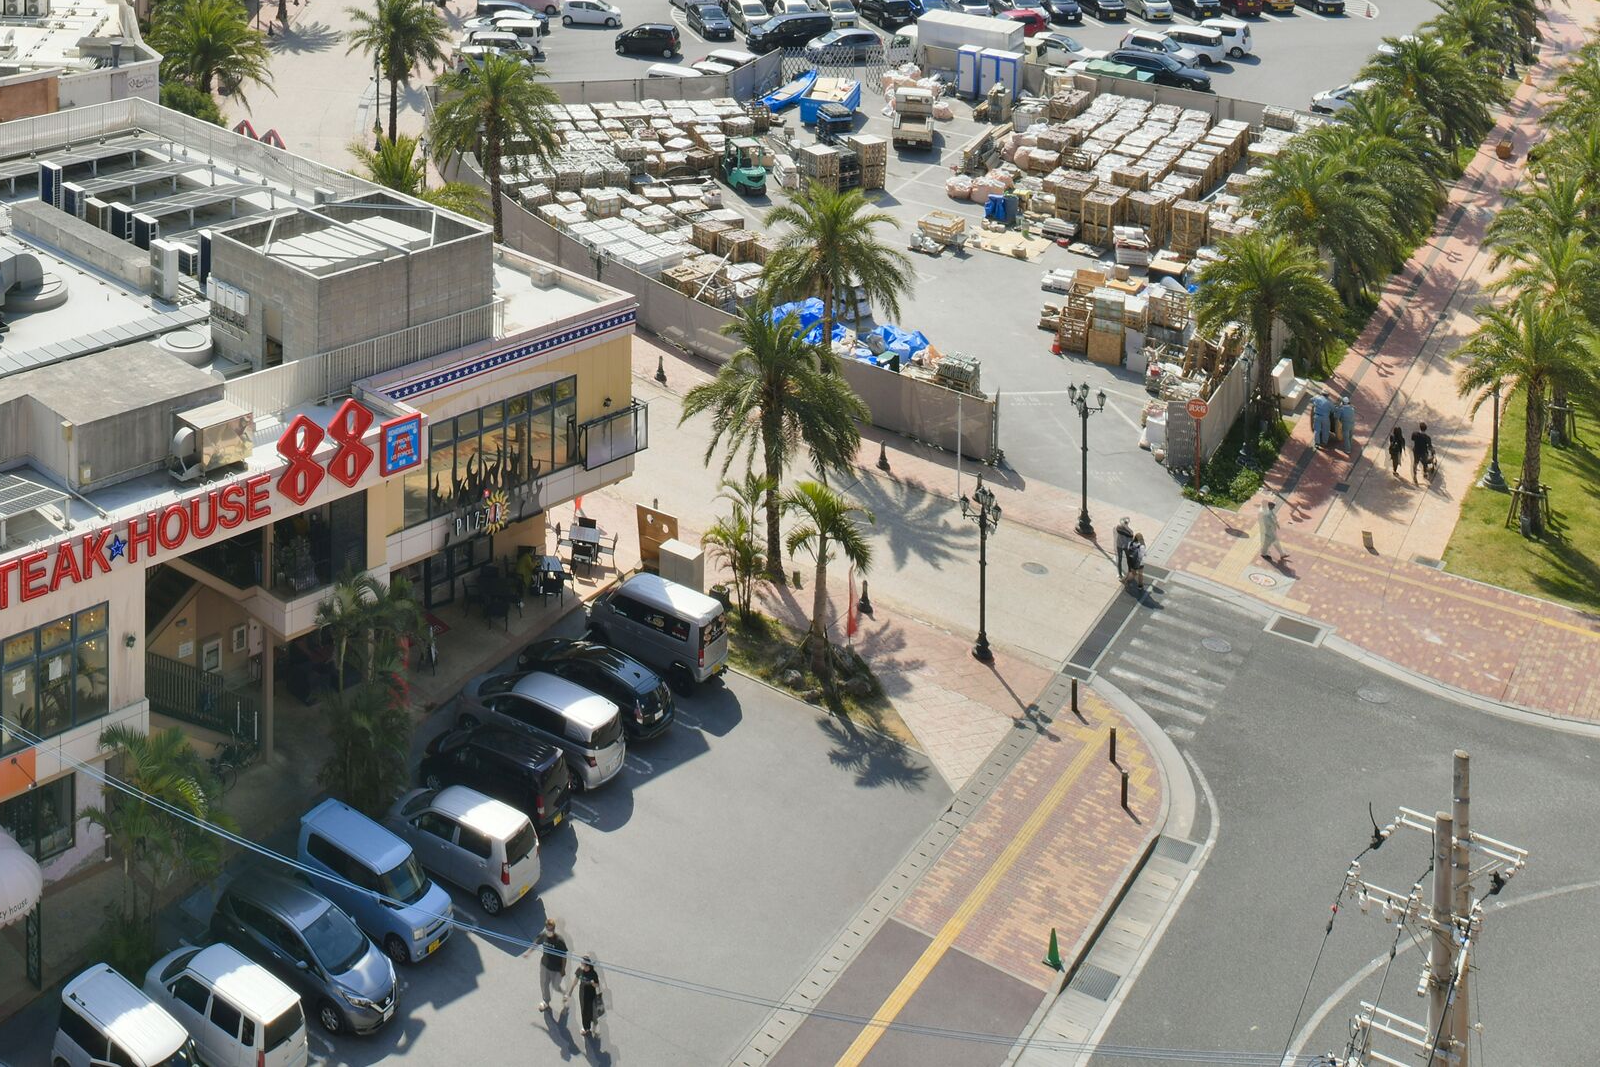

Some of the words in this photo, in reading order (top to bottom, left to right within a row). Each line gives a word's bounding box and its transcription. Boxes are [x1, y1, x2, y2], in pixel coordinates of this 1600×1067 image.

[277, 397, 375, 506] 88
[128, 473, 272, 564] HOUSE
[8, 897, 29, 916] house
